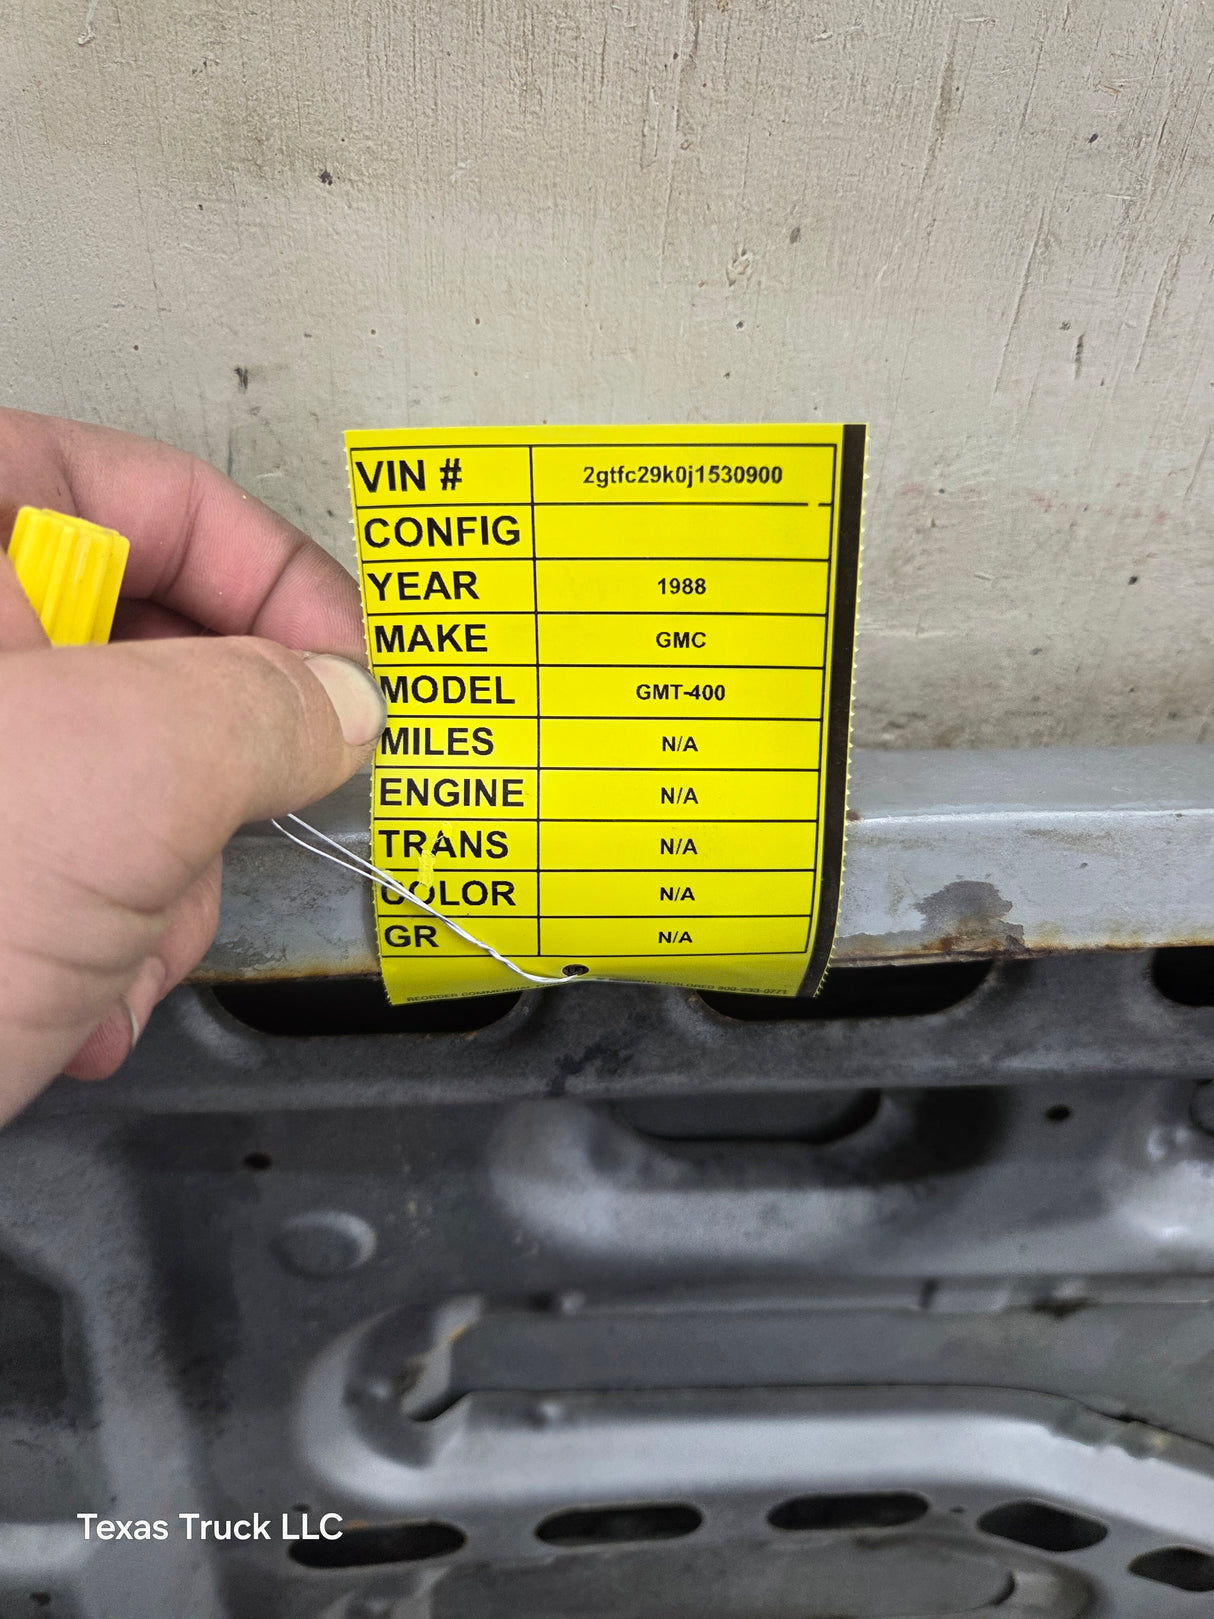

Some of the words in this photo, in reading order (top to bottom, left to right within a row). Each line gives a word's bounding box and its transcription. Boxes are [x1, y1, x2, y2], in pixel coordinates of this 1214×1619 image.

[355, 459, 426, 493] VIN
[439, 457, 463, 491] #
[583, 465, 783, 489] 2gtfc29k0j1530900
[364, 515, 520, 549] CONFIG
[366, 570, 480, 602] YEAR
[657, 577, 707, 595] 1988
[374, 623, 488, 653] MAKE
[655, 631, 707, 649] GMC
[380, 674, 516, 705] MODEL
[636, 684, 726, 701] GMT-400
[380, 726, 494, 756] MILES
[662, 736, 699, 752] N/A
[380, 777, 524, 807] ENGINE
[661, 787, 699, 805] N/A
[378, 829, 509, 859] TRANS
[660, 838, 698, 855] N/A
[660, 886, 696, 902] N/A
[384, 924, 440, 948] GR
[658, 930, 693, 944] N/A
